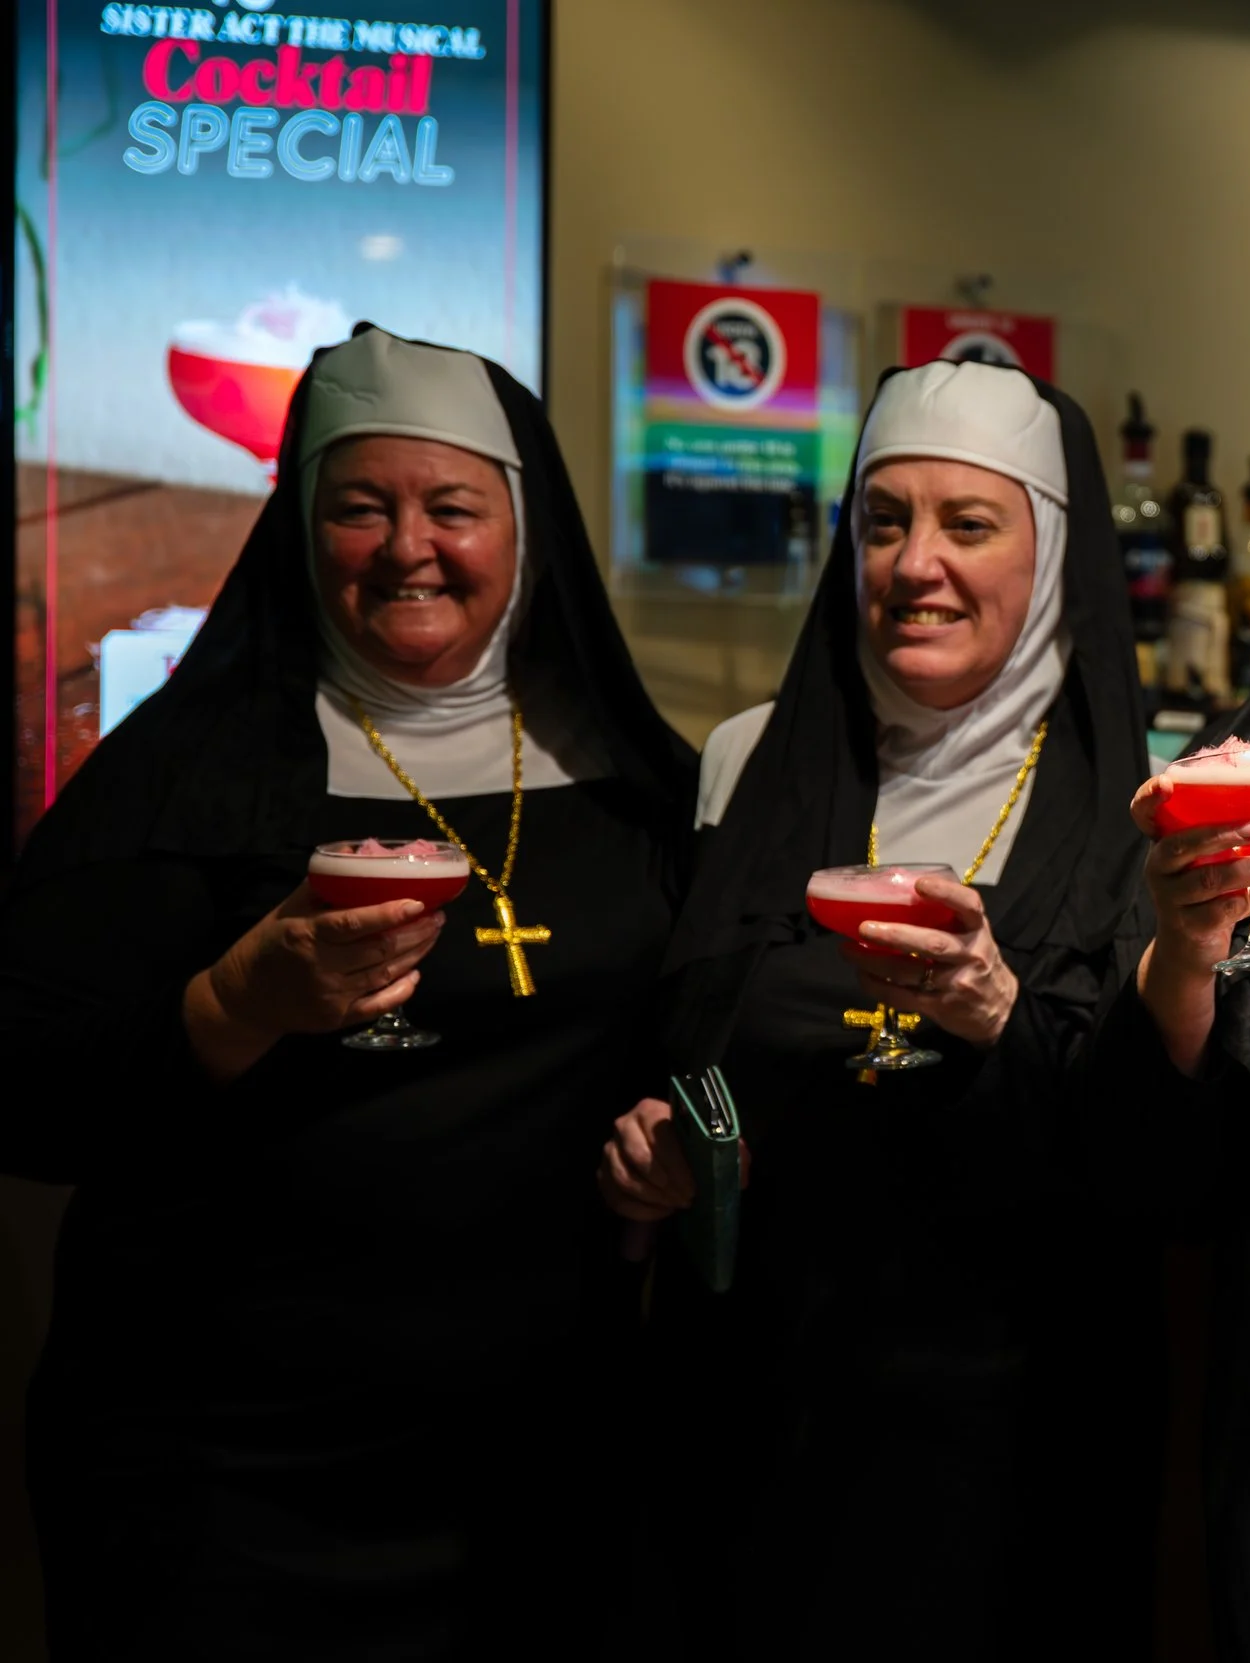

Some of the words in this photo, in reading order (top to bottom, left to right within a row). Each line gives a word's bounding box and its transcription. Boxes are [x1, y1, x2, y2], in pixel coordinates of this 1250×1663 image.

[100, 2, 216, 42] SISTER
[216, 10, 284, 46] ACT
[284, 15, 351, 51] THE
[352, 19, 486, 59] MUSICAL
[143, 37, 434, 115] Cocktail
[123, 100, 454, 186] SPECIAL
